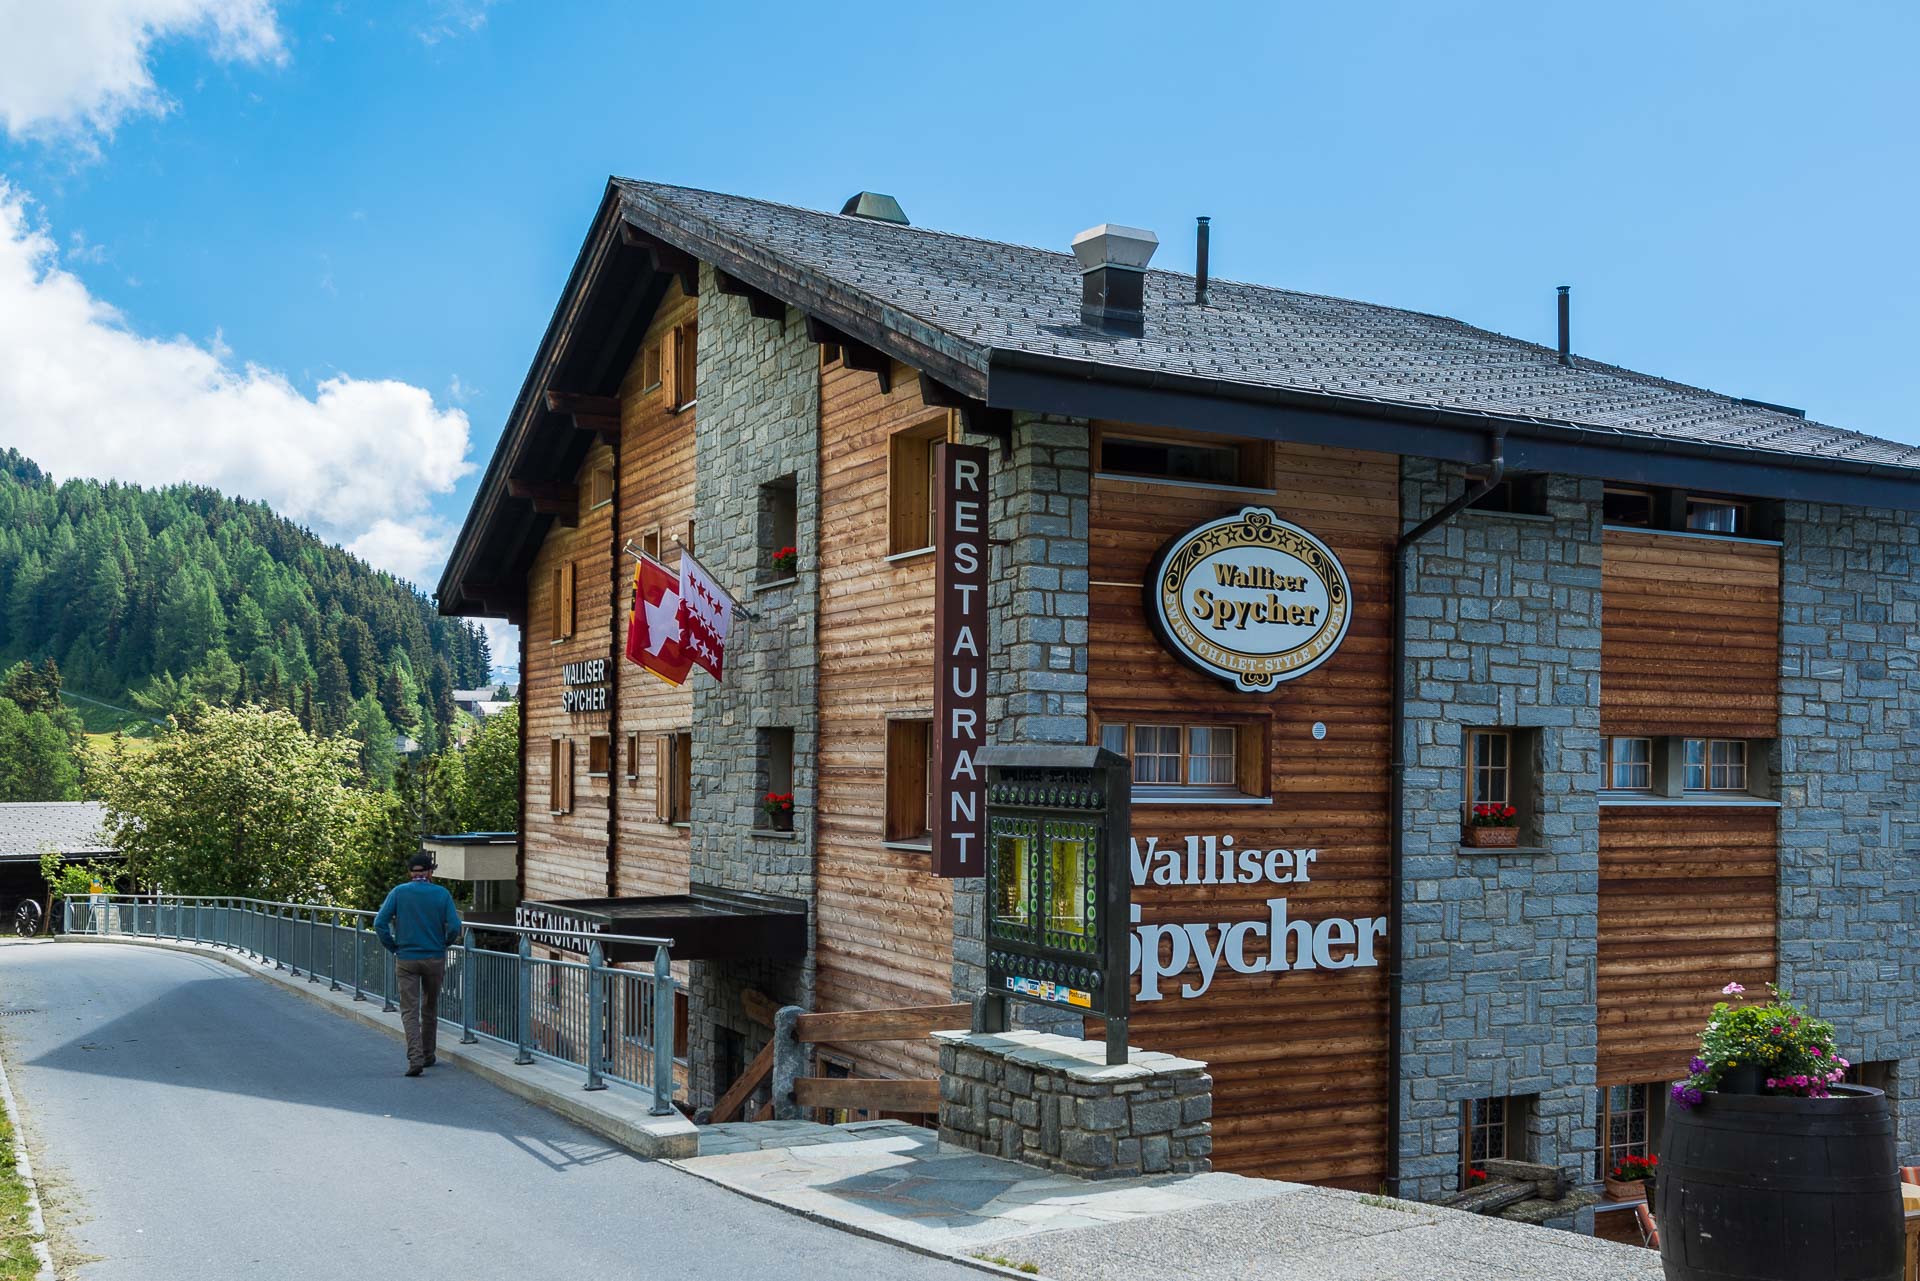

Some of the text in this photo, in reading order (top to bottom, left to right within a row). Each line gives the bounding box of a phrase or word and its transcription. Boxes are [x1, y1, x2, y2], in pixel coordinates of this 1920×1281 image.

[1212, 562, 1308, 592] Walliser
[1191, 588, 1319, 630] Spycher
[1166, 593, 1344, 672] SWISS CHALET-STYLE HOTEL
[562, 658, 605, 686] WALLISER
[950, 459, 979, 864] RESTAURANT
[562, 687, 606, 713] SPYCHER
[1130, 897, 1387, 1002] pycher
